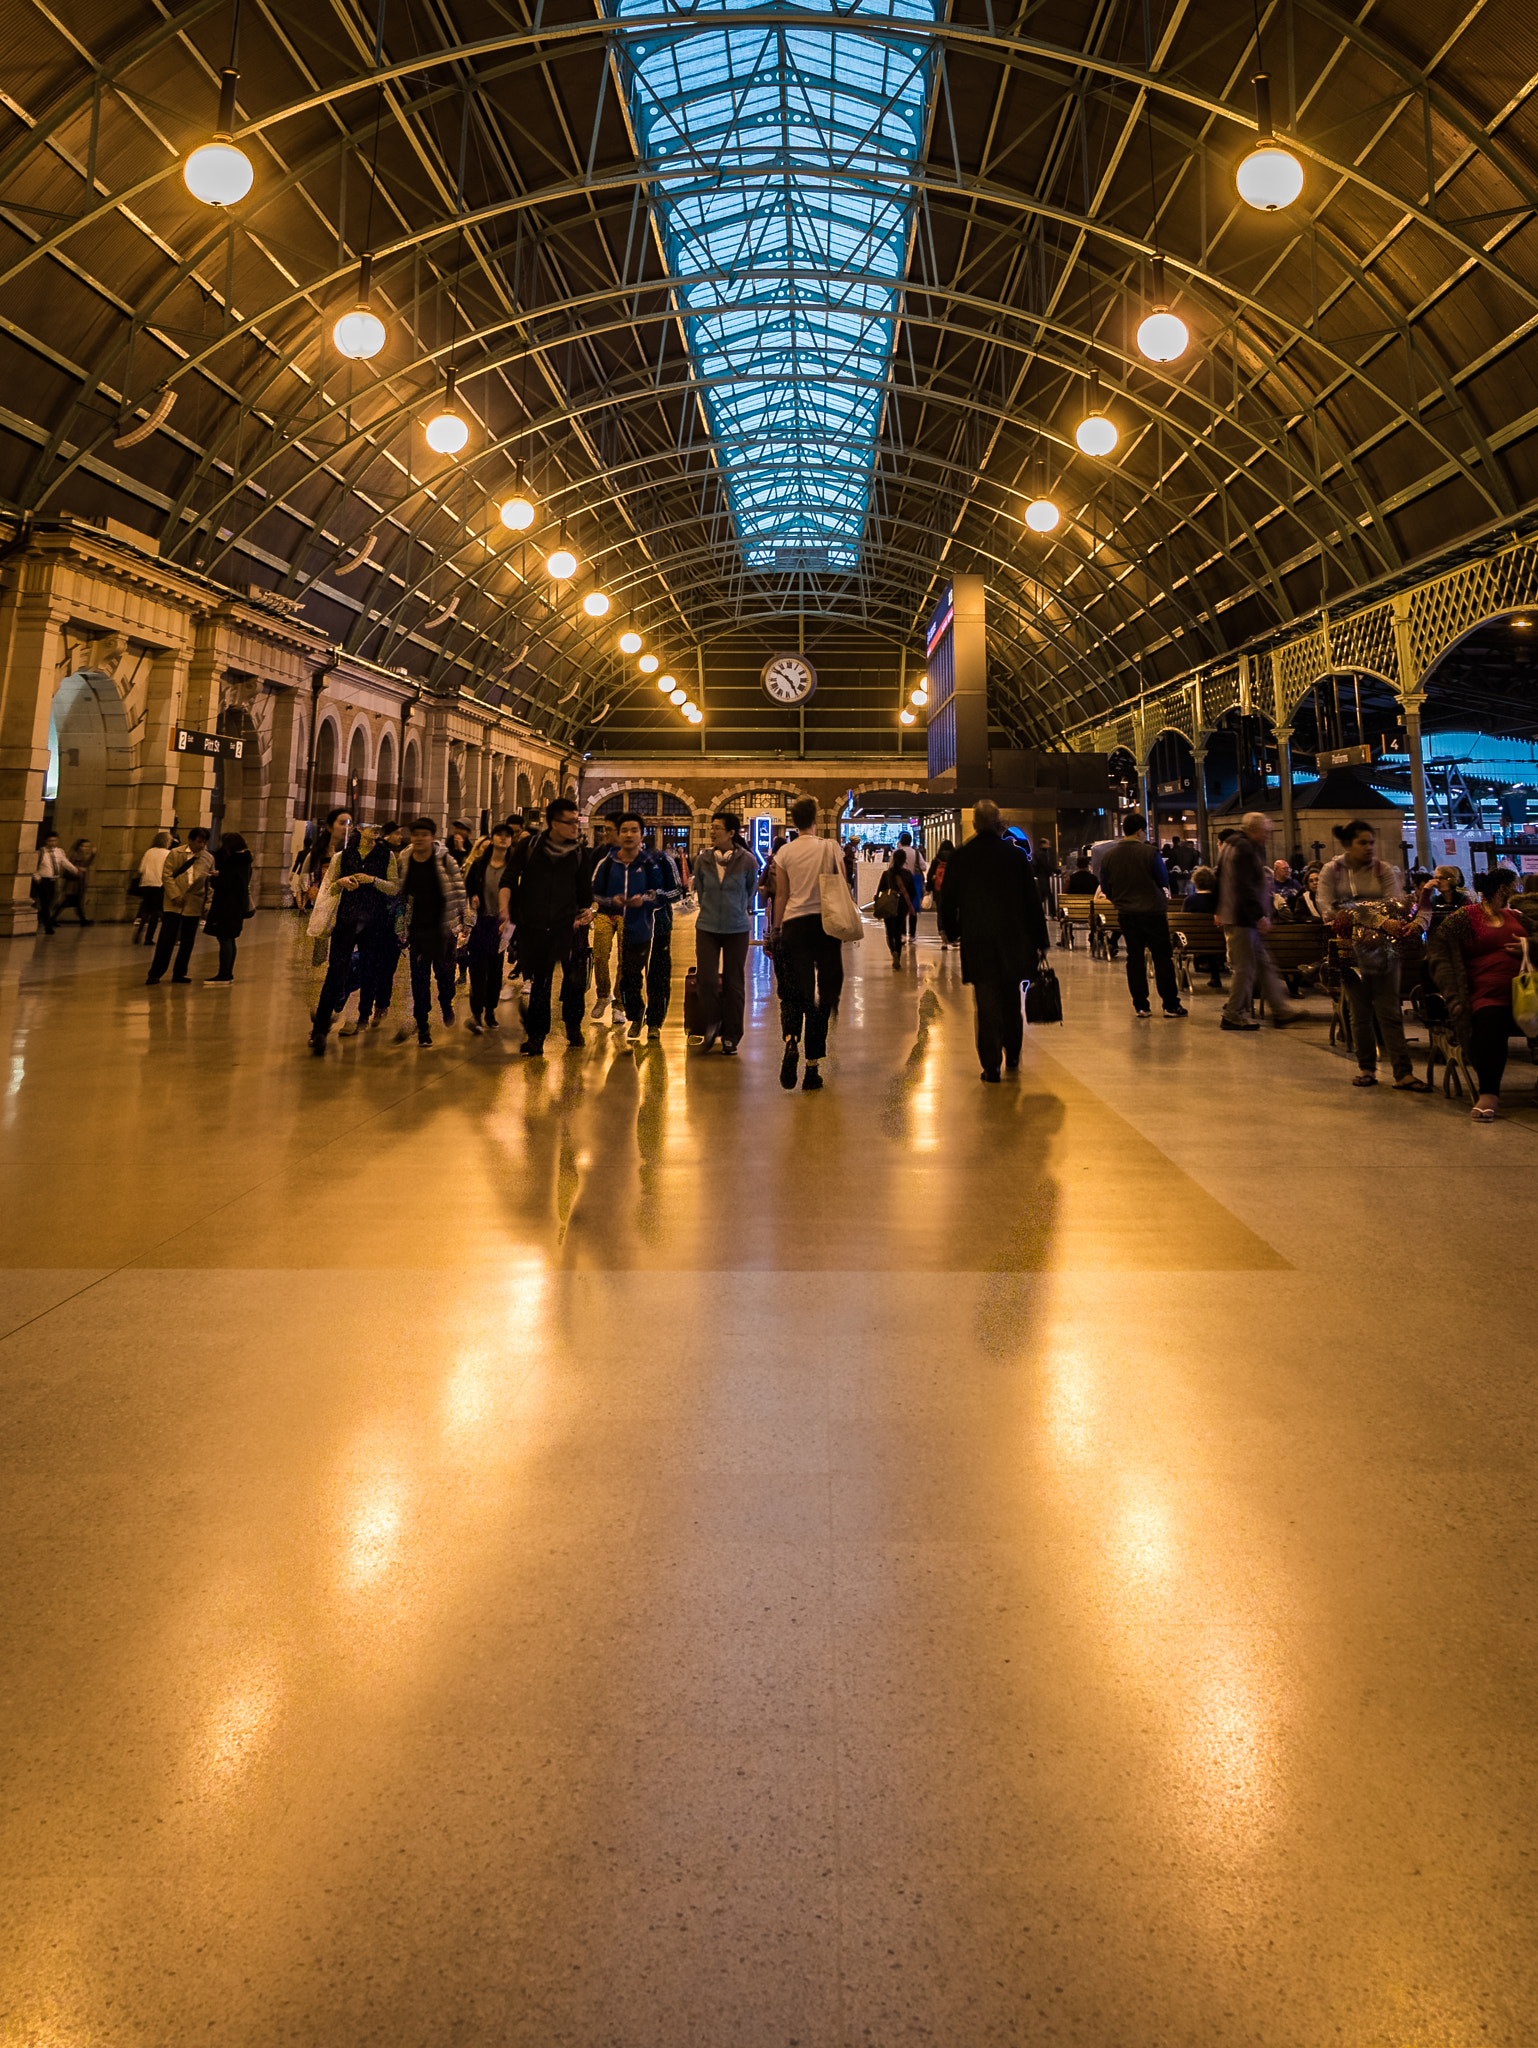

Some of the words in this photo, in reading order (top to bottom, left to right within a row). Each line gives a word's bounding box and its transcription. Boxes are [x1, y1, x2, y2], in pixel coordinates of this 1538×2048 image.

[204, 738, 214, 752] Pitt
[214, 739, 220, 753] St
[1390, 738, 1399, 750] 4
[1265, 763, 1272, 773] 5
[1183, 778, 1190, 787] 6
[1129, 789, 1134, 797] 7
